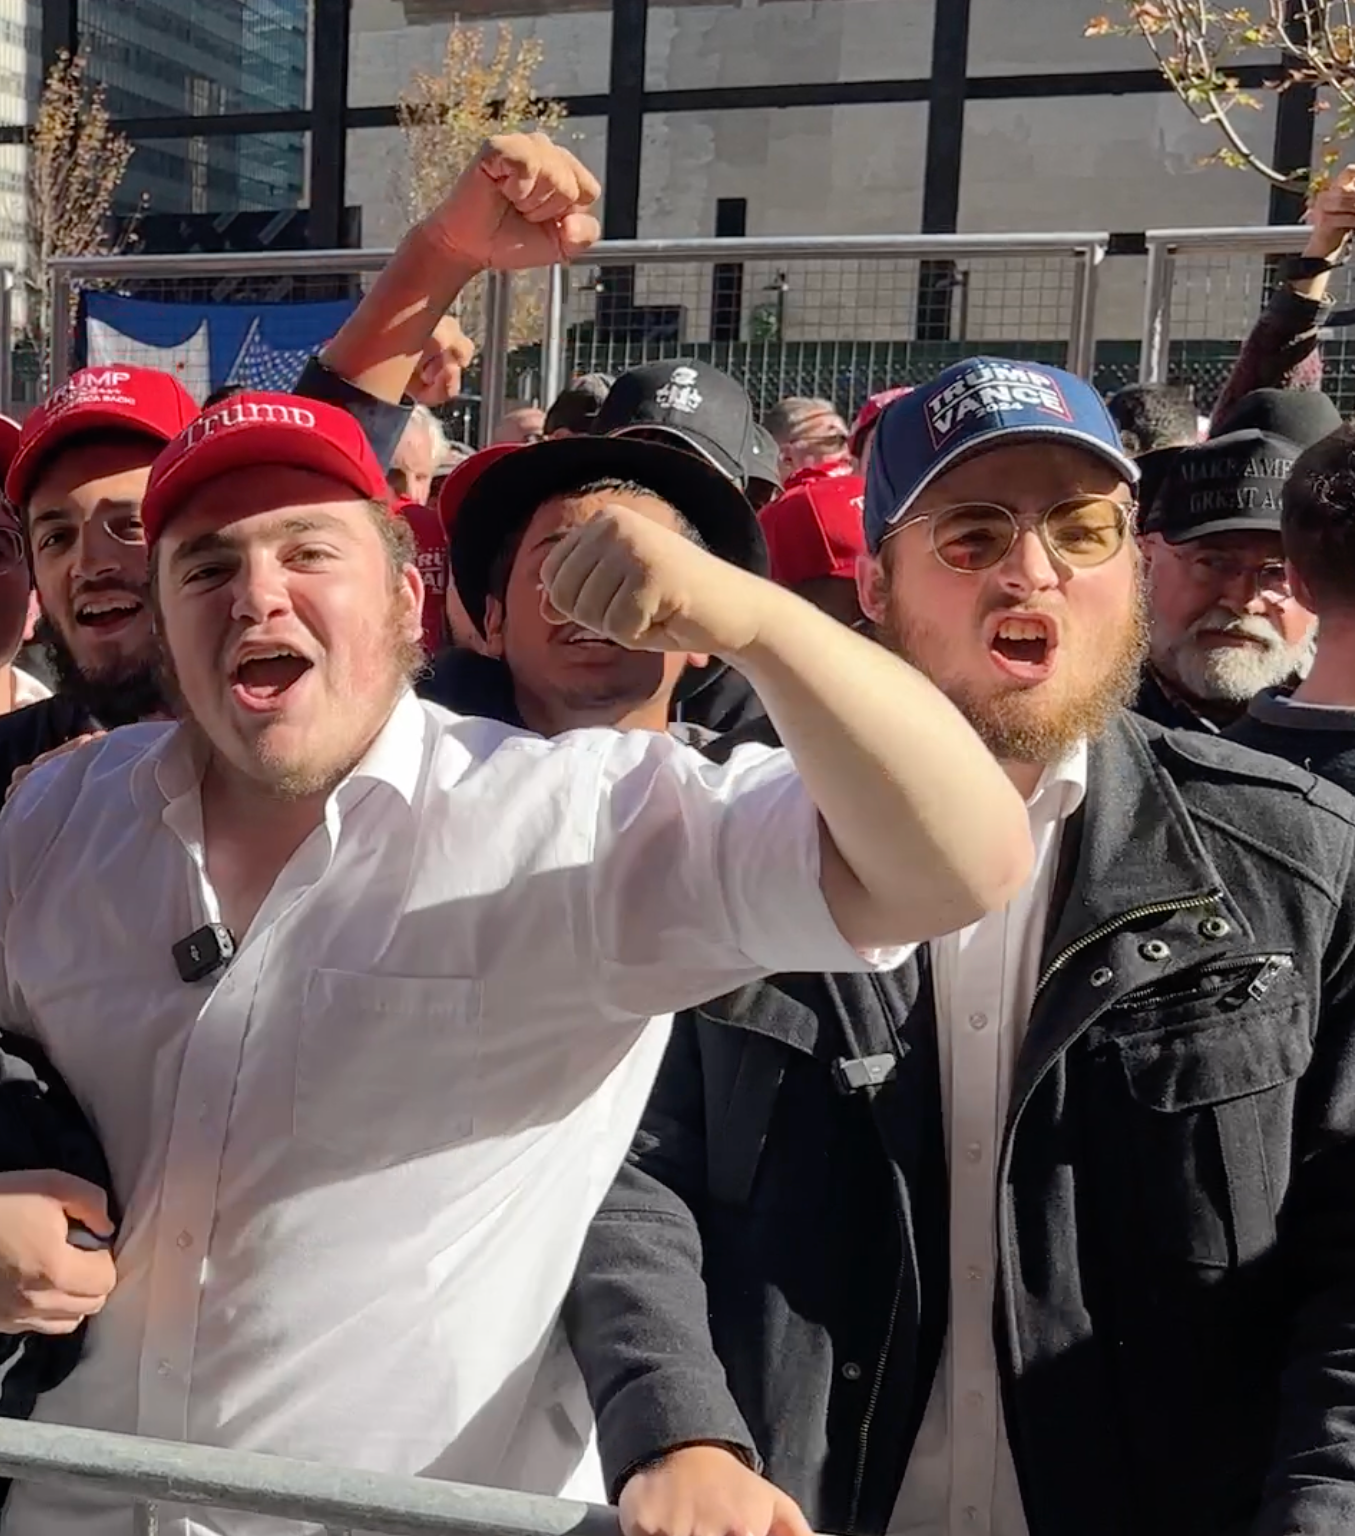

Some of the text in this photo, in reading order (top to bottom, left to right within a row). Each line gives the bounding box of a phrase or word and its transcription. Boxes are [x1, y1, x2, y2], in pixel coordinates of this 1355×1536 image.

[928, 367, 1054, 412] TRUMP
[934, 385, 1065, 435] VANCE
[975, 402, 1024, 418] 2024
